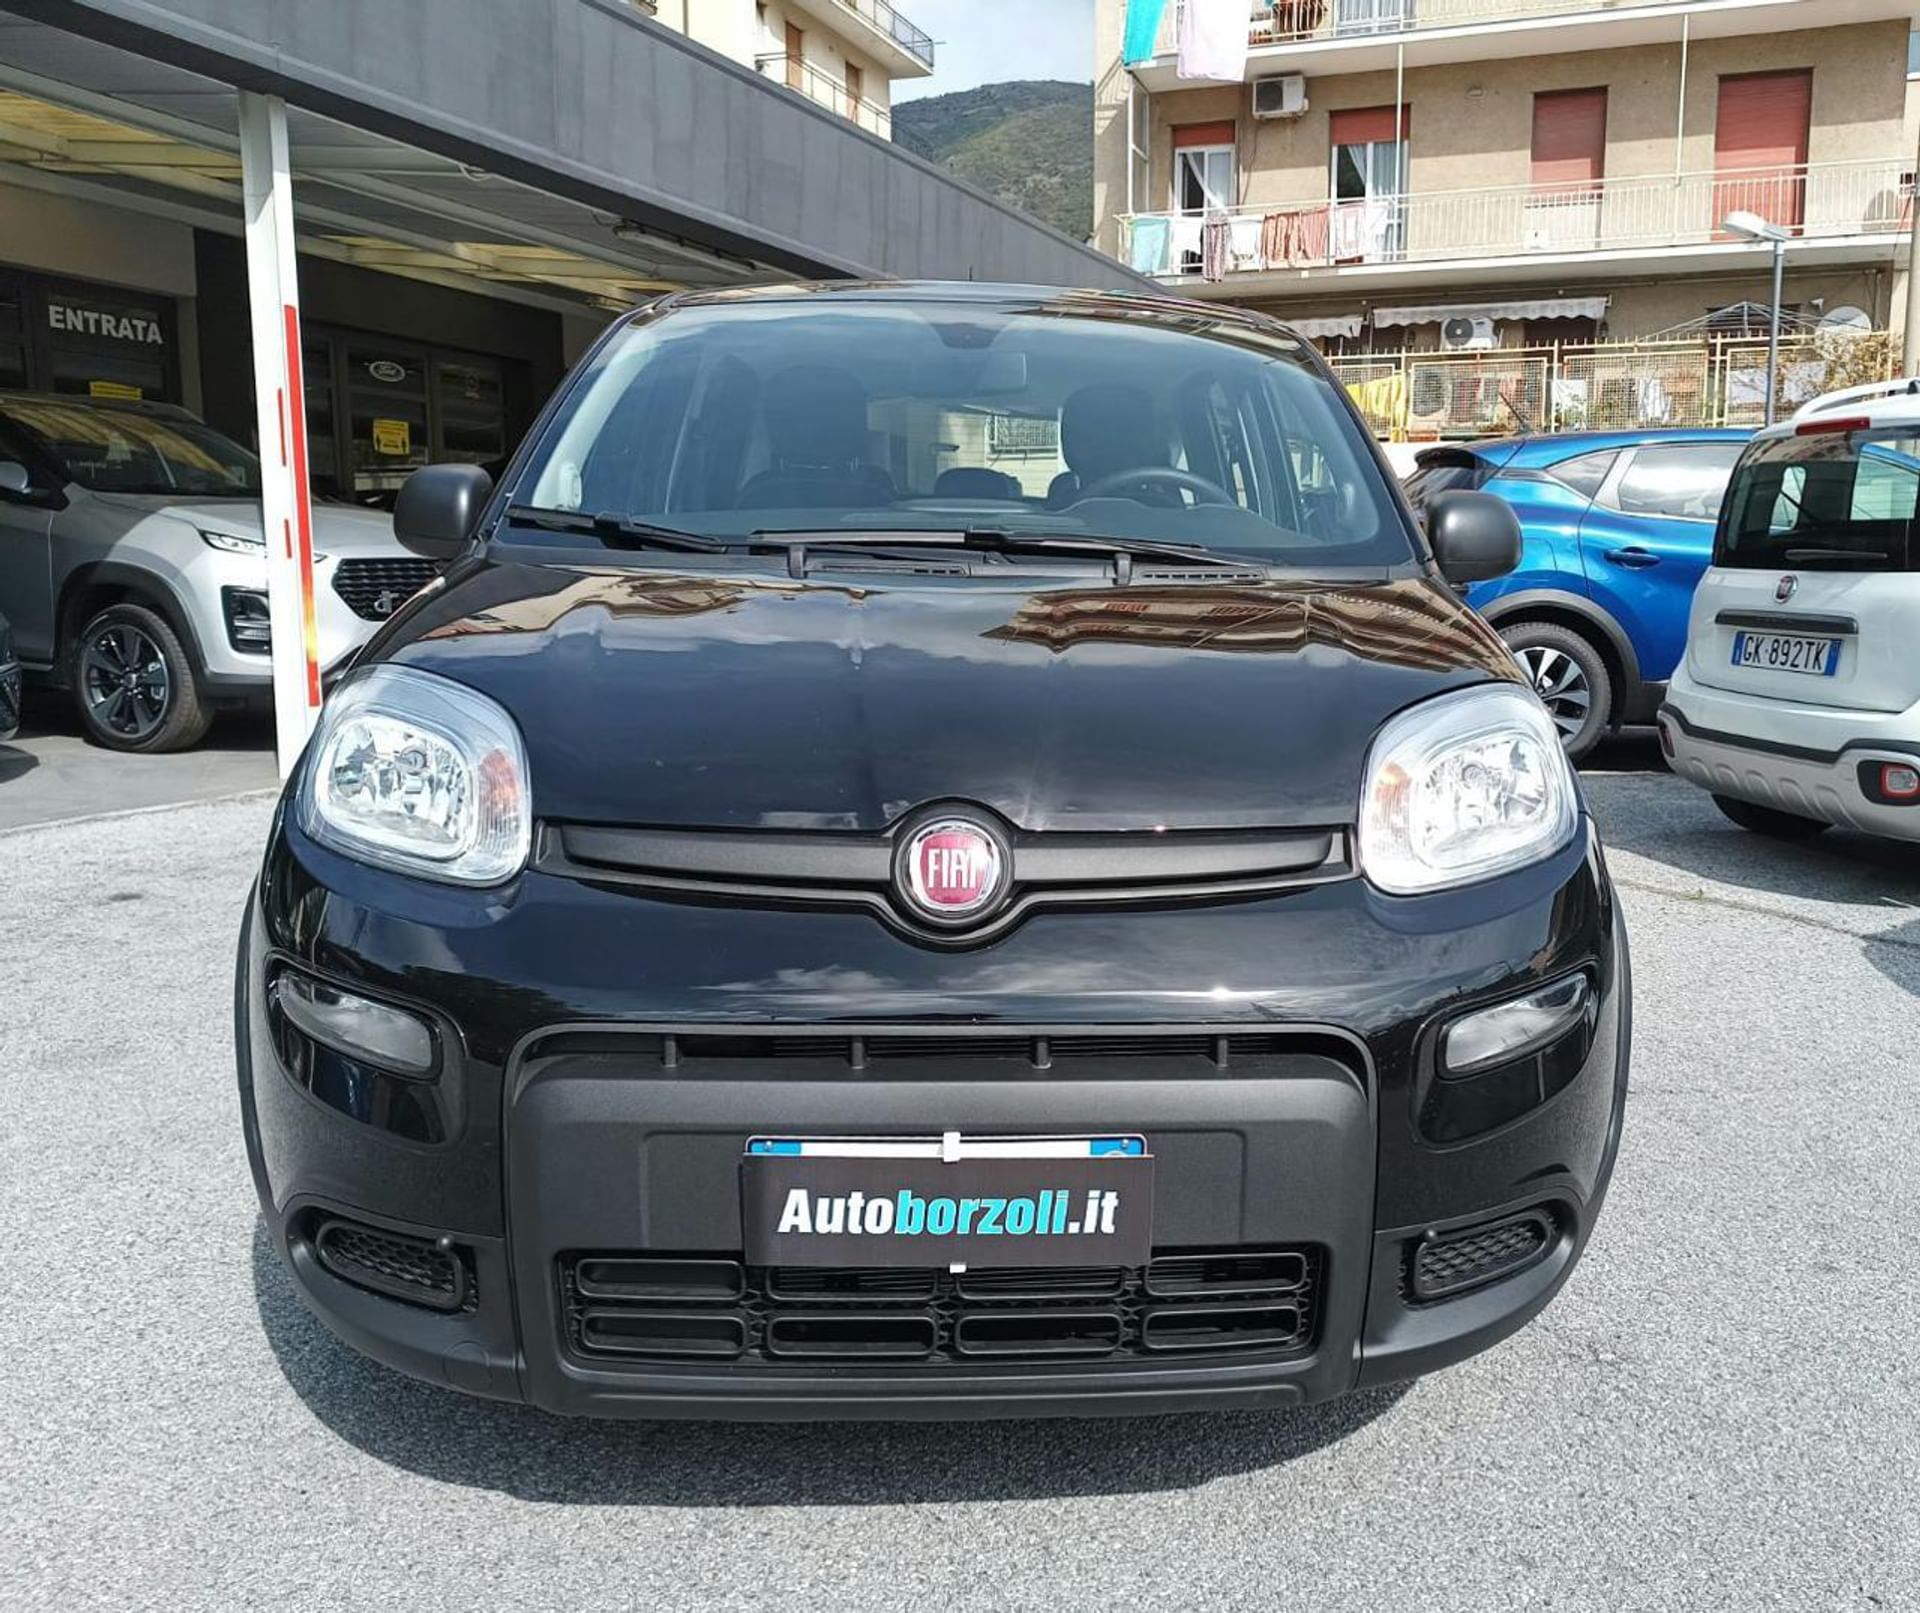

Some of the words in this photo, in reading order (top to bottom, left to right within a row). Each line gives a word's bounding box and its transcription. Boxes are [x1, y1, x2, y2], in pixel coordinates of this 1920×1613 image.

[48, 304, 163, 345] ENTRATA
[927, 847, 981, 889] FIAT
[778, 1188, 1120, 1235] Autoborzoli.it
